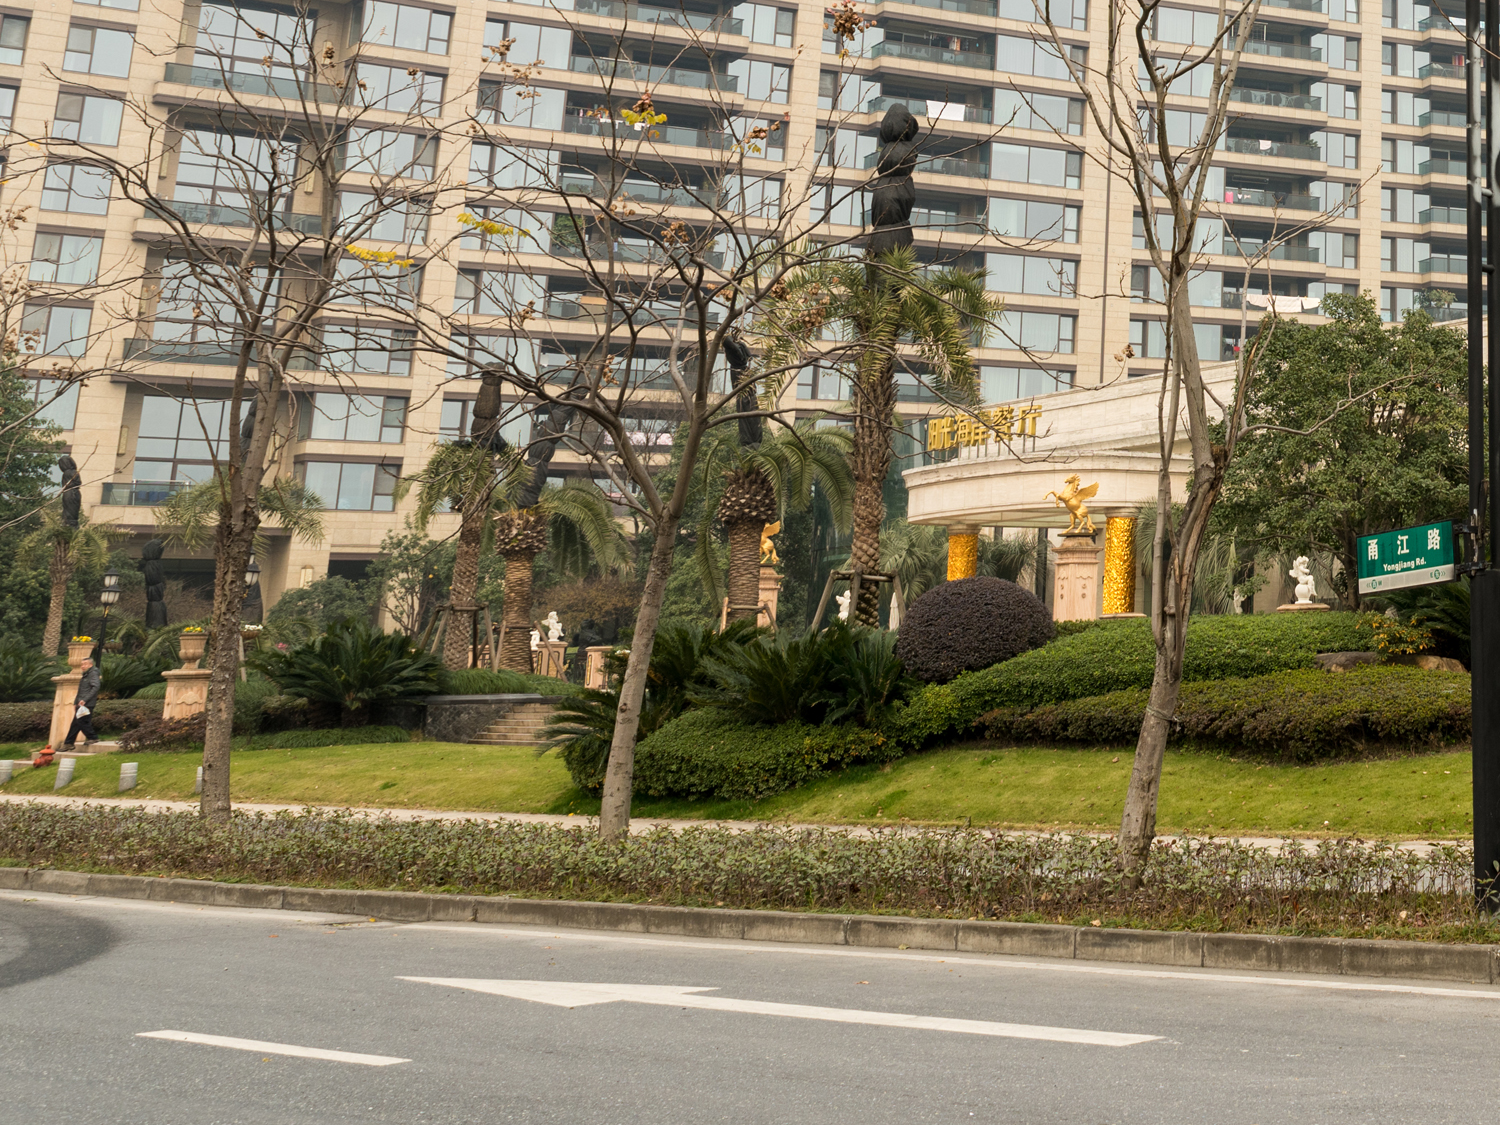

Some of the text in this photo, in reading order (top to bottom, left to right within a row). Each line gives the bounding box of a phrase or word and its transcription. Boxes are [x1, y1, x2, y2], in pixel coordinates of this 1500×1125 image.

[927, 404, 1042, 452] 阳光海岸餐厅
[1367, 528, 1441, 561] 甬江路
[1383, 557, 1427, 572] Yongjiang Rd.
